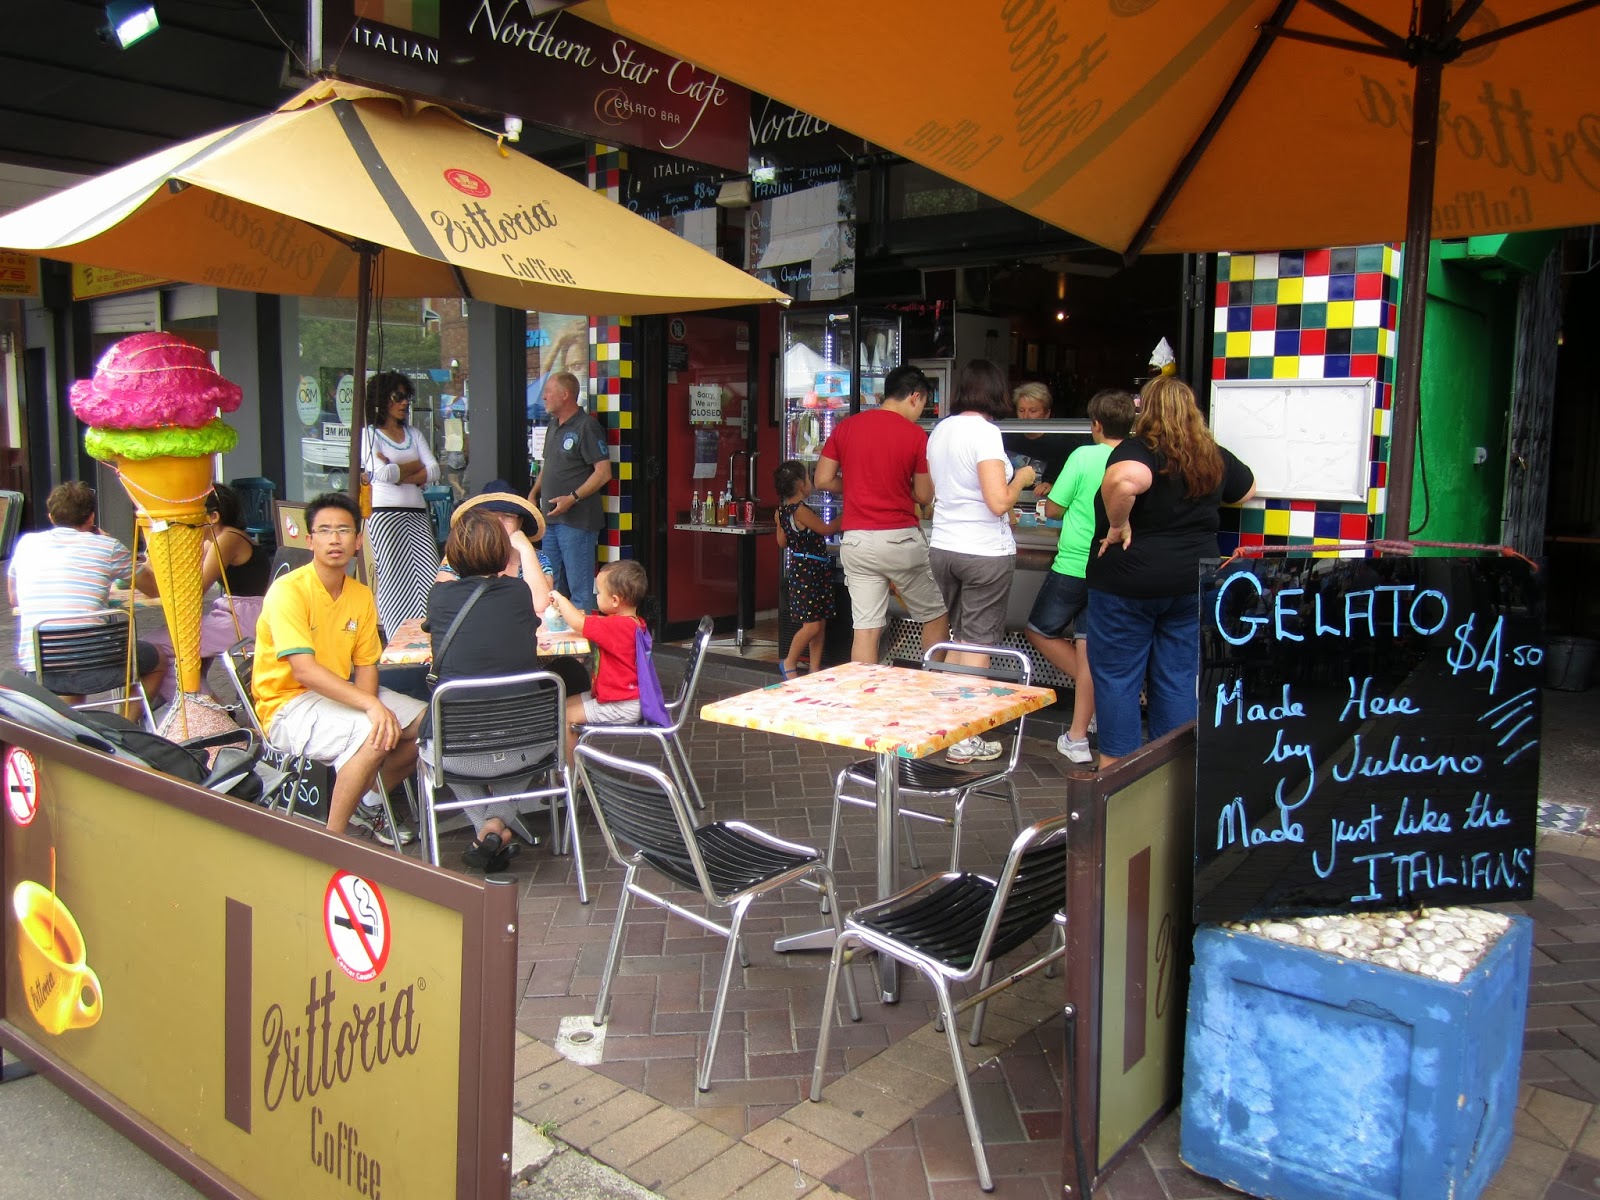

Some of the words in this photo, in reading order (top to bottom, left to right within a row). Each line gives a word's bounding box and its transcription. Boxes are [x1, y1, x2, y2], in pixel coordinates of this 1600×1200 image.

[354, 28, 439, 65] ITALIAN
[468, 0, 597, 68] Northern
[601, 39, 659, 85] Star
[661, 110, 680, 125] BAR
[754, 179, 793, 198] PANINI
[430, 201, 557, 253] Vittoria
[501, 253, 577, 285] Coffee
[691, 409, 722, 417] CLOSED
[1214, 570, 1449, 646] GELATO
[1446, 612, 1544, 695] $4.50
[1214, 679, 1307, 728] Made
[1338, 676, 1421, 723] Here
[1262, 729, 1317, 811] by
[1331, 734, 1484, 783] Juliano
[1216, 796, 1306, 851] Made
[1312, 803, 1384, 880] just
[1394, 796, 1452, 837] like
[1462, 790, 1511, 831] the
[336, 956, 356, 978] Cancer
[355, 968, 378, 981] Council
[262, 968, 421, 1112] Vittoria
[311, 1106, 382, 1200] Coffee
